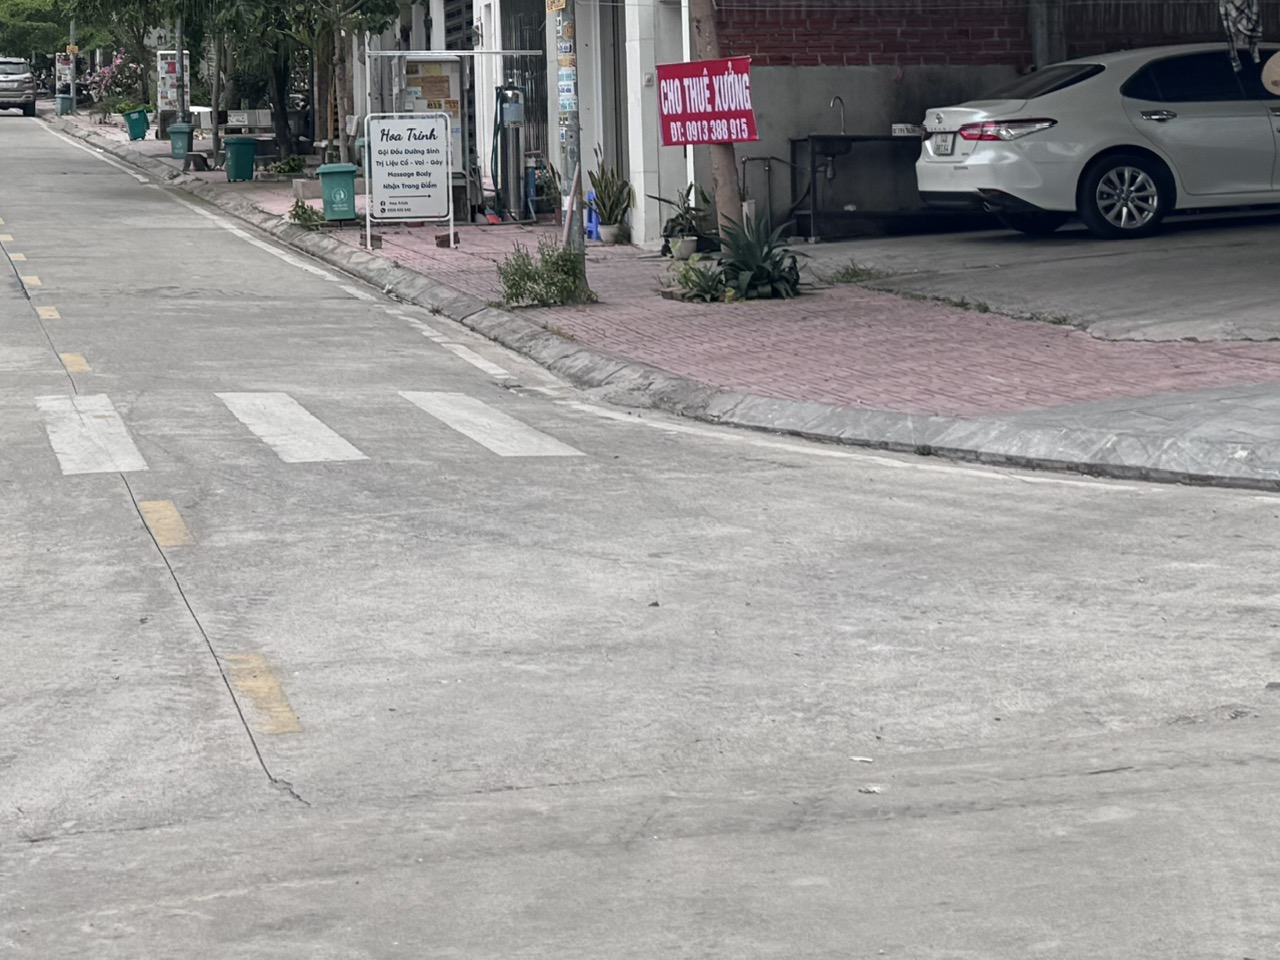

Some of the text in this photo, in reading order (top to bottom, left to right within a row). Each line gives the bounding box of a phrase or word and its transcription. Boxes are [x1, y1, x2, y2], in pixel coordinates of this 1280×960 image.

[660, 60, 752, 115] CHO THUÊ XƯỞNG
[380, 127, 438, 142] Hoa Trinh
[670, 118, 749, 142] ĐT: 0913 388 915
[377, 148, 389, 157] Gội
[386, 159, 399, 167] Liệu
